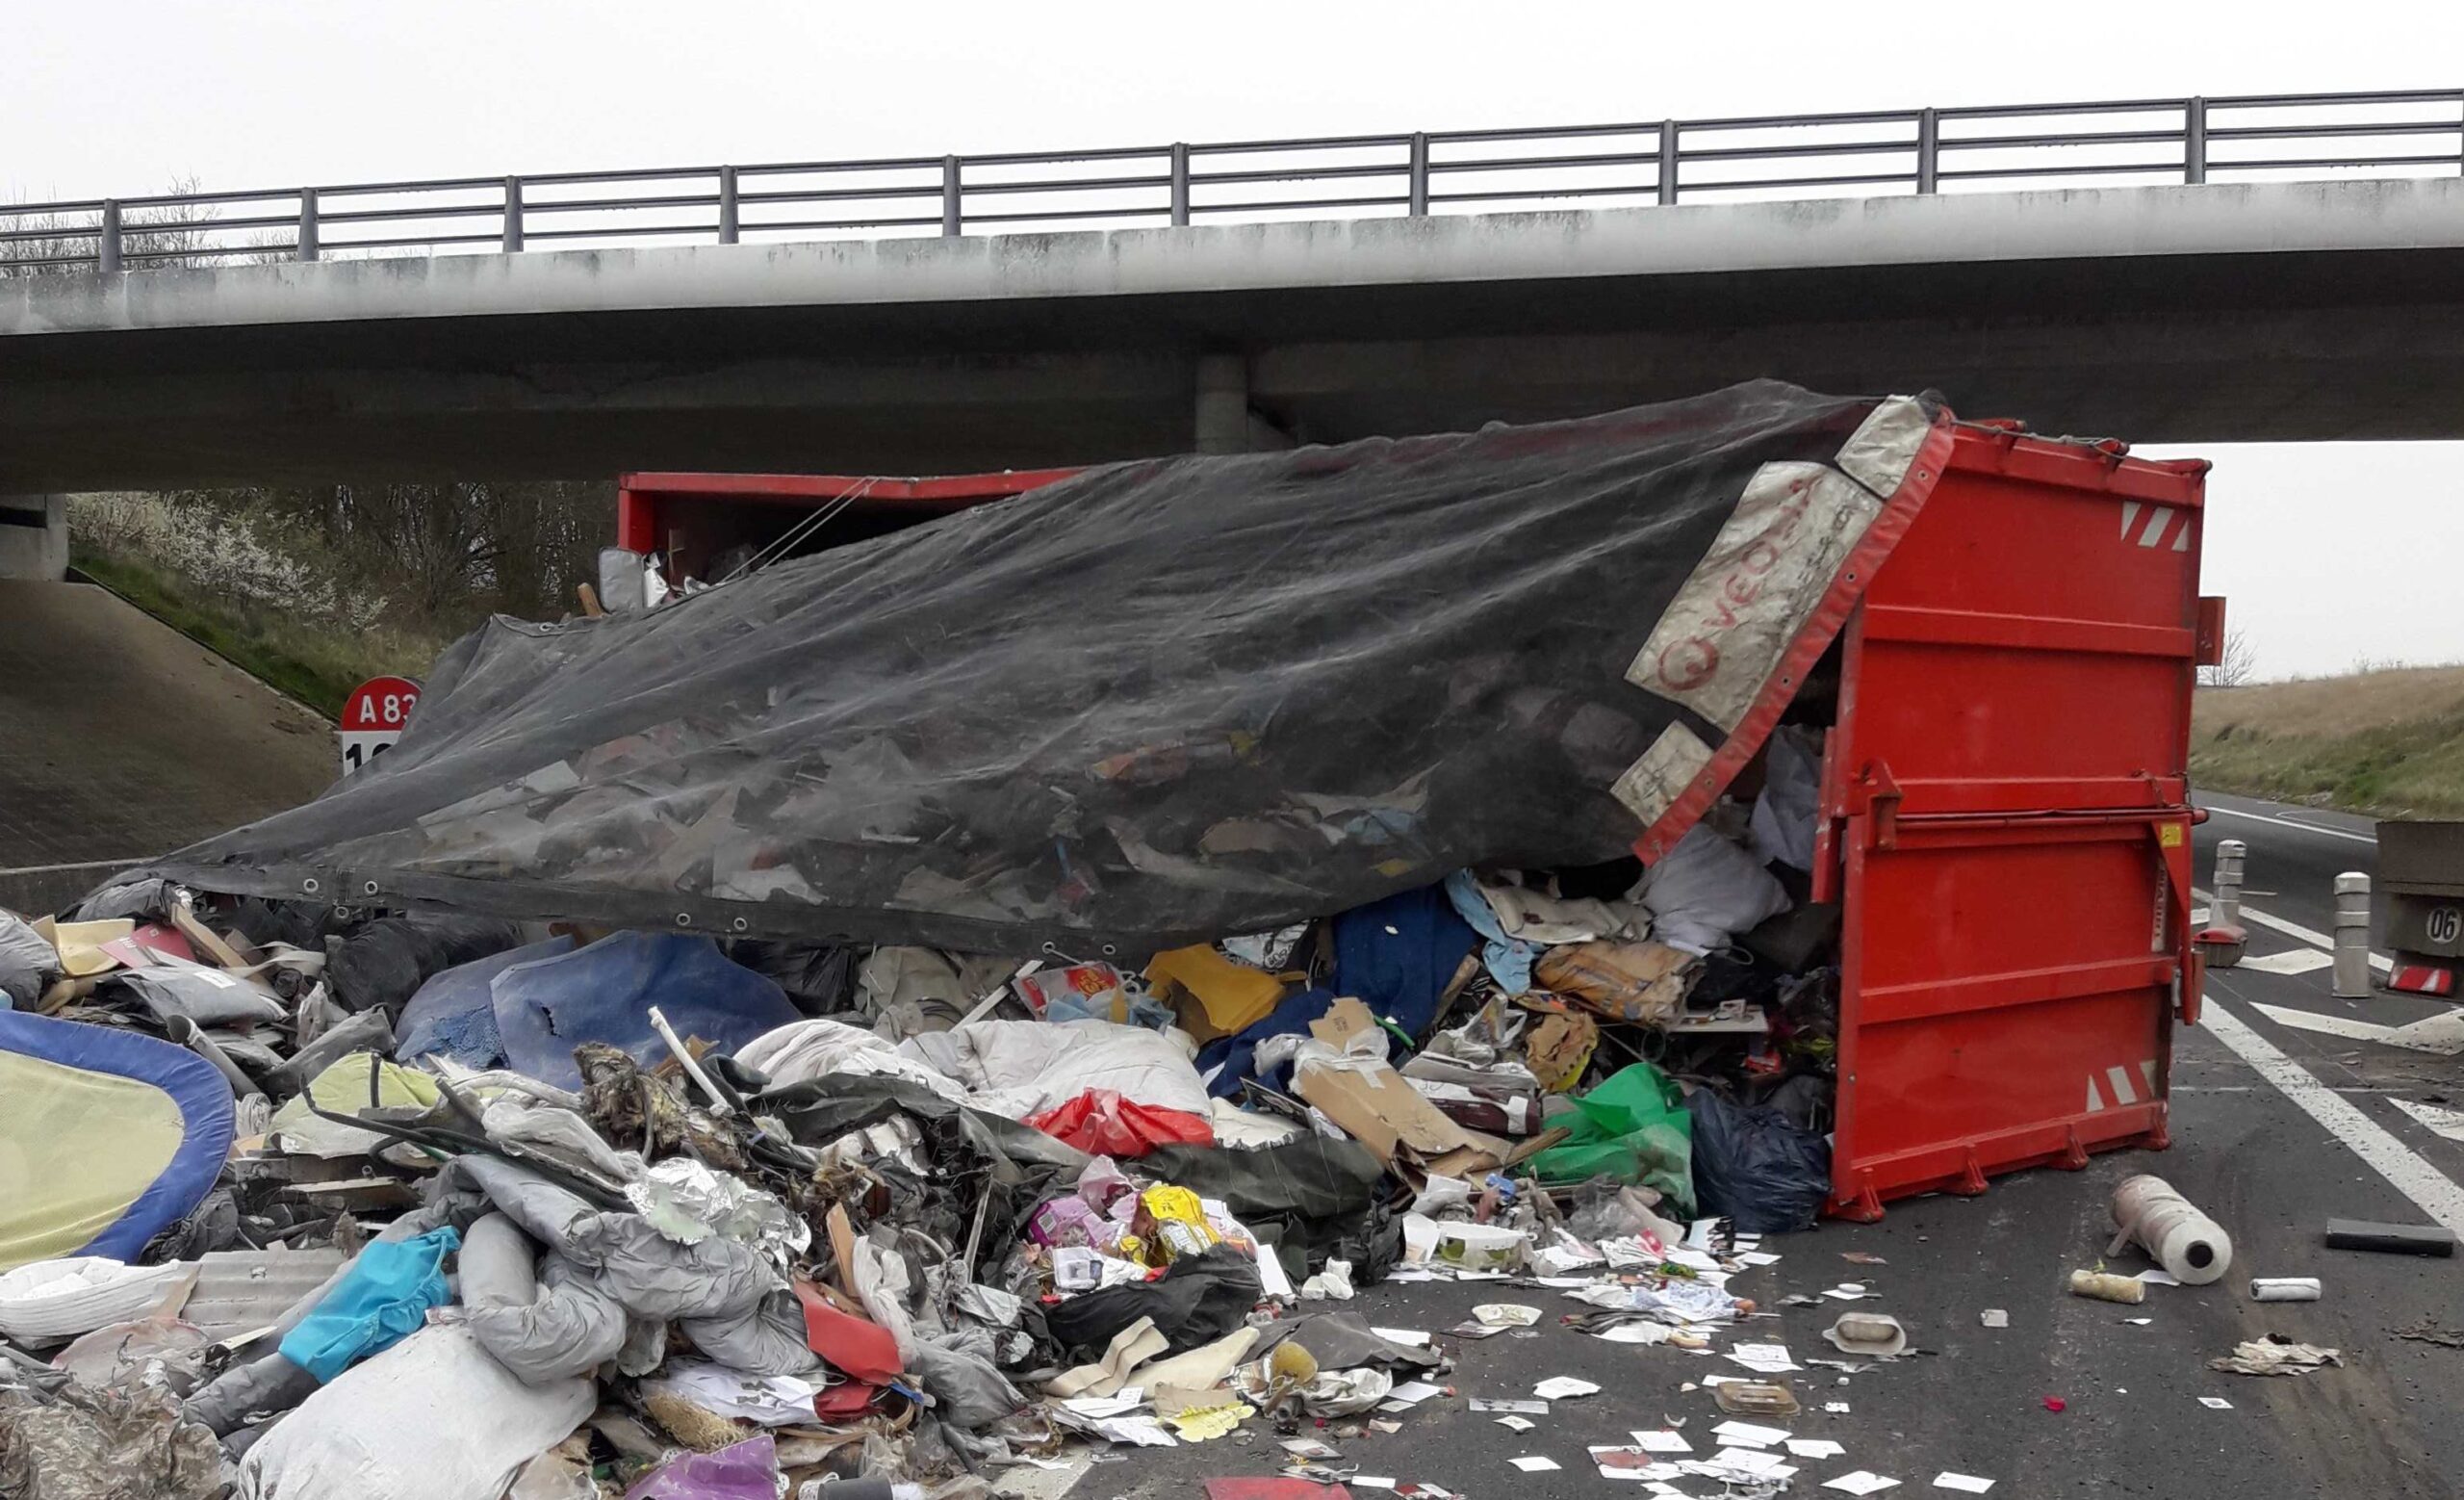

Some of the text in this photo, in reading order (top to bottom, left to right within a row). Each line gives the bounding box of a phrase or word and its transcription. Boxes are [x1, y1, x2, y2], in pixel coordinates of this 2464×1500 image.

[360, 695, 376, 723] A
[346, 743, 393, 769] 1
[2430, 909, 2458, 940] 06
